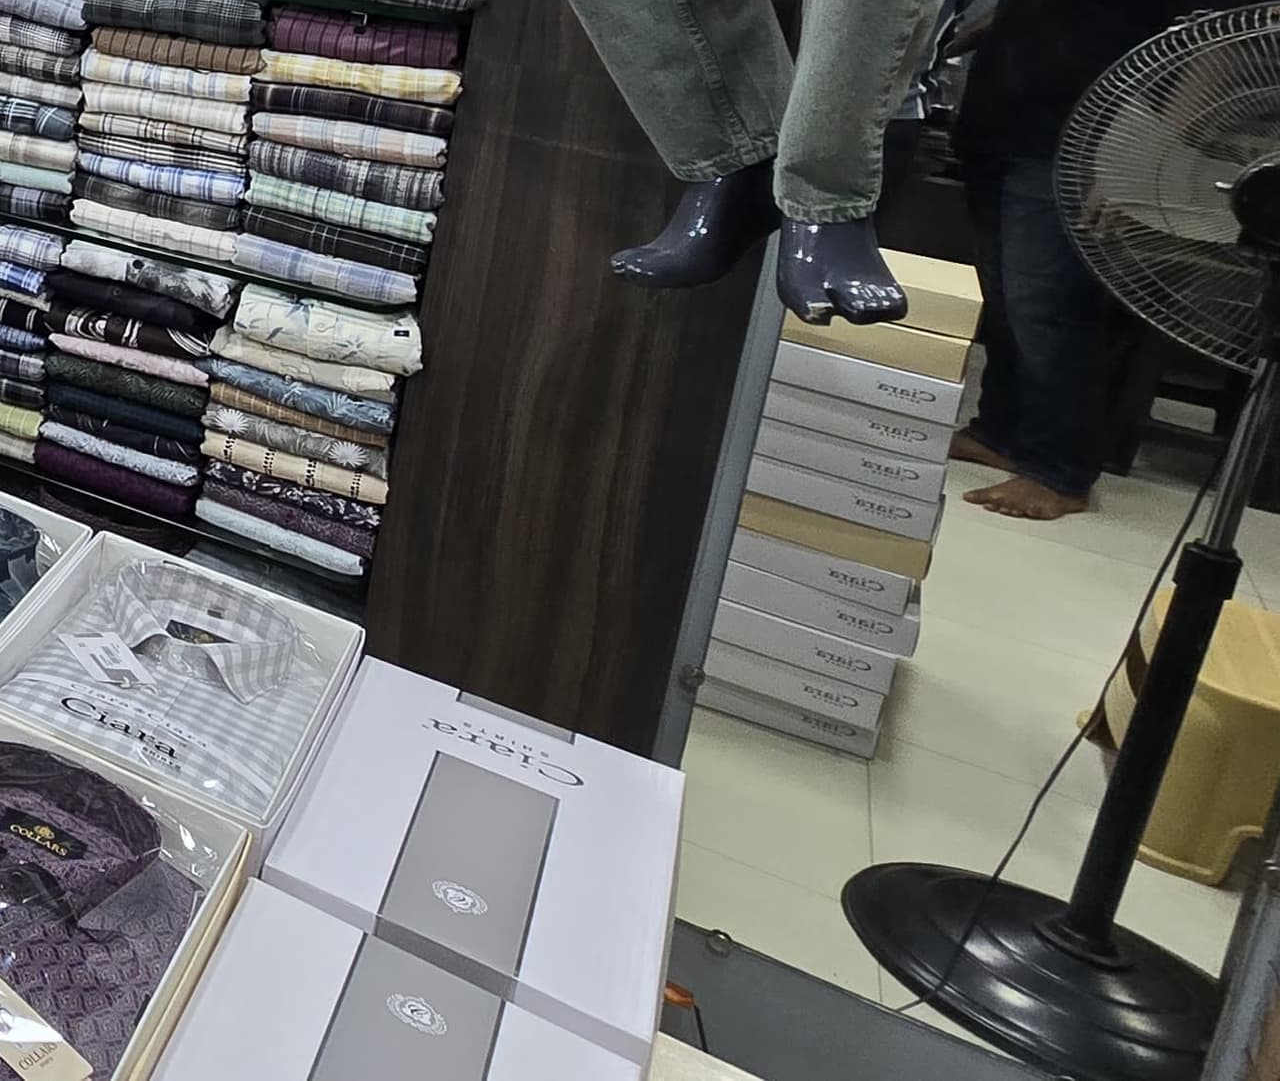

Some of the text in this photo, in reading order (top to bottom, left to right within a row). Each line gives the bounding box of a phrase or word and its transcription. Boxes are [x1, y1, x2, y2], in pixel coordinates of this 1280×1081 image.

[60, 696, 178, 759] Ciara
[428, 718, 585, 787] Ciara
[9, 824, 69, 857] COLLARS
